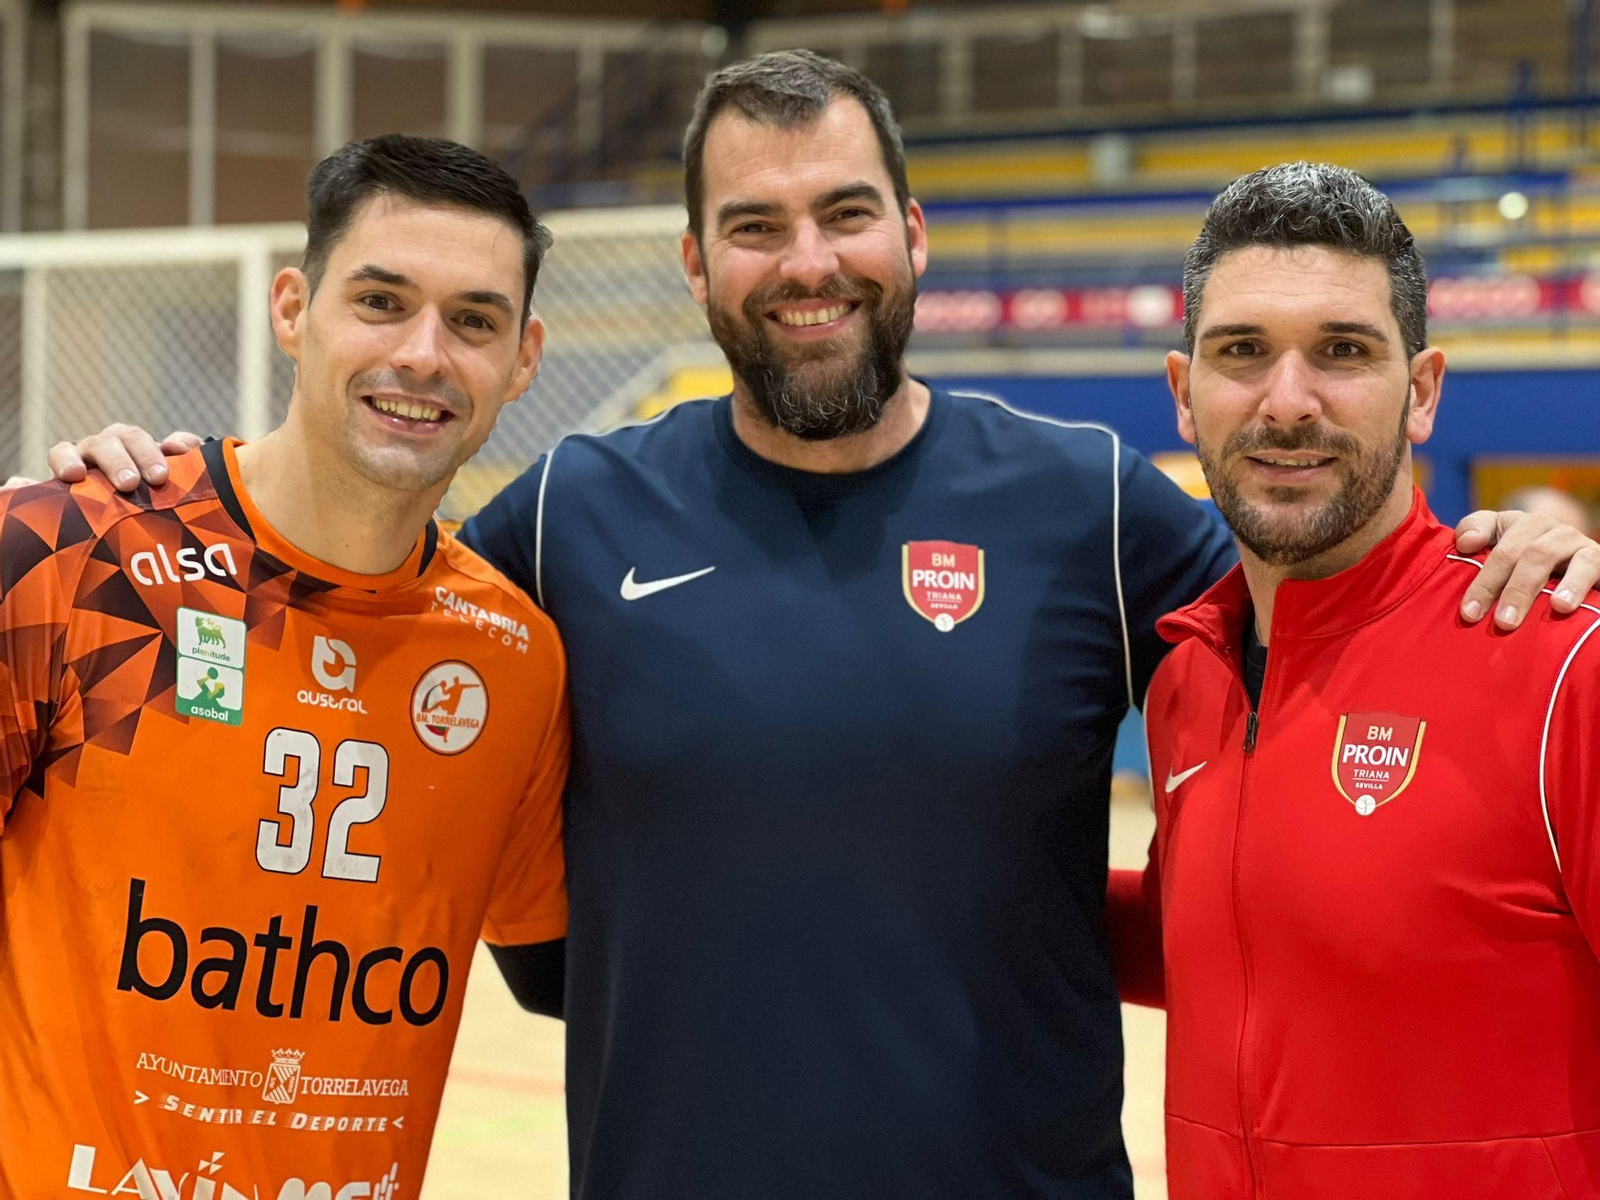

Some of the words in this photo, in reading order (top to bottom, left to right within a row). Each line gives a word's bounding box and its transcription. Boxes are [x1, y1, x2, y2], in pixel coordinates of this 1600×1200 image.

[130, 543, 237, 586] alsa
[931, 552, 955, 568] BM
[912, 569, 975, 591] PROIN
[926, 591, 962, 601] TRIANA
[435, 586, 530, 641] CANTABRIA
[430, 601, 528, 655] TELECOM
[192, 646, 231, 662] plenitude
[191, 704, 229, 722] asobal
[297, 689, 368, 714] austral
[431, 714, 480, 728] TORRELAVEGA
[1366, 725, 1393, 741] BM
[1342, 743, 1409, 767] PROIN
[1353, 769, 1390, 780] TRIANA
[1355, 782, 1383, 790] SEVILLA
[255, 727, 390, 883] 32
[116, 878, 450, 1026] bathco
[136, 1052, 263, 1088] AYUNTAMIENTO
[301, 1075, 409, 1097] TORRELAVEGA
[161, 1094, 242, 1124] SENTIR
[251, 1110, 276, 1126] EL
[289, 1113, 388, 1132] DEPORTE
